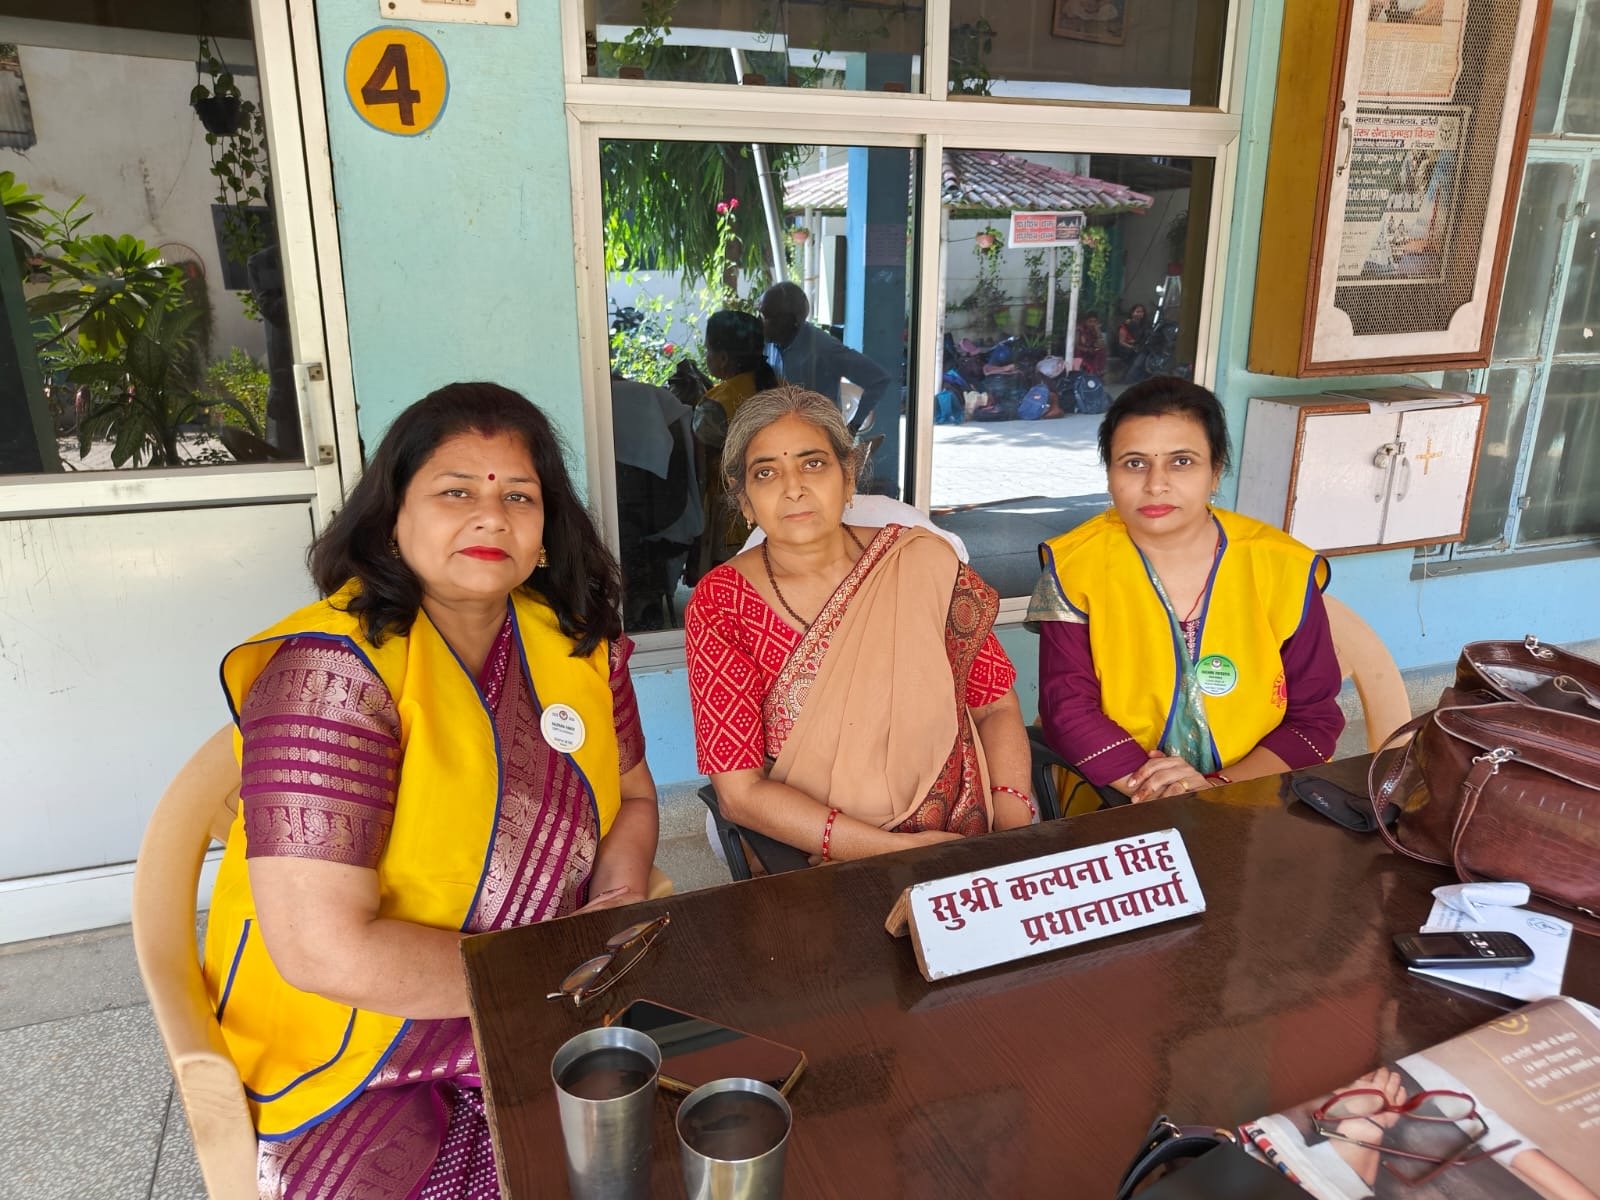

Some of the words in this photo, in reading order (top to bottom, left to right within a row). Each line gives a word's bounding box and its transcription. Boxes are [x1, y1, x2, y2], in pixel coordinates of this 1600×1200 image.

[361, 43, 421, 126] 4
[928, 877, 1003, 930] सुश्री
[1006, 855, 1114, 902] कल्पना
[1115, 839, 1177, 876] सिंह
[1021, 872, 1189, 945] प्रधानाचार्या
